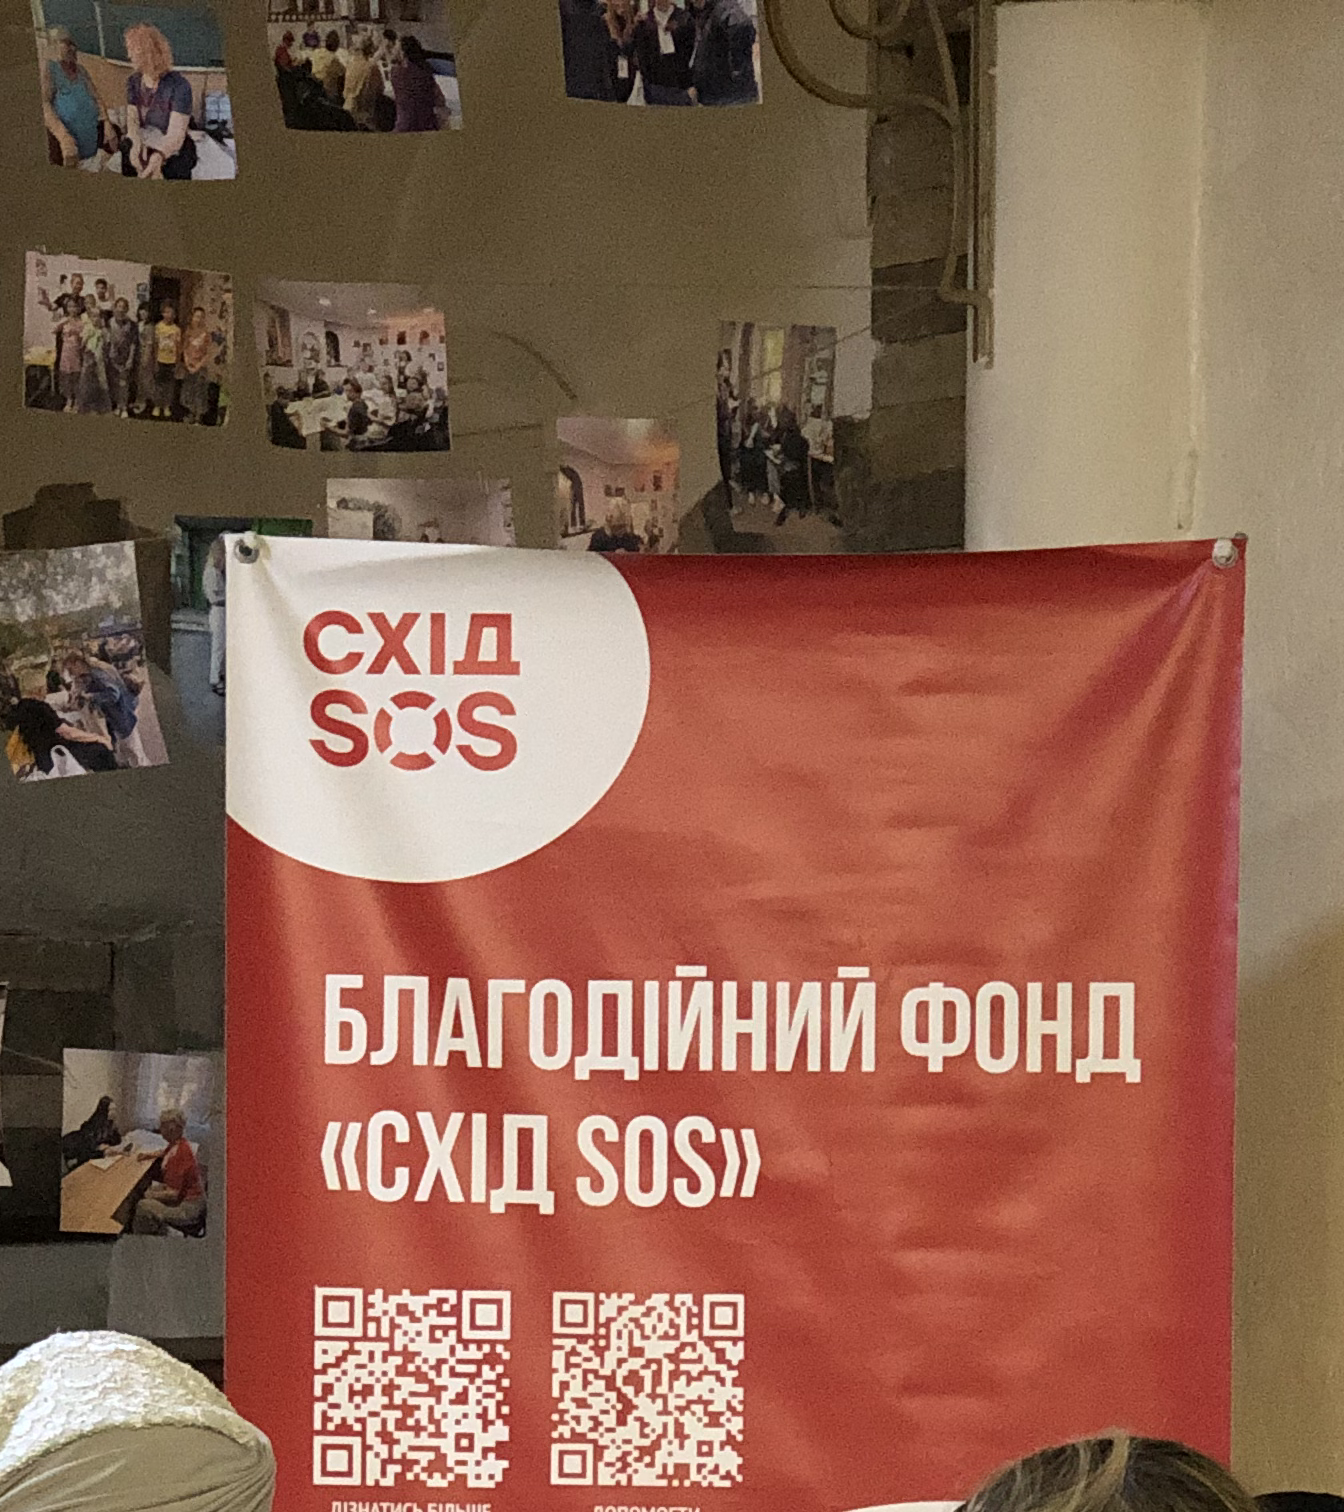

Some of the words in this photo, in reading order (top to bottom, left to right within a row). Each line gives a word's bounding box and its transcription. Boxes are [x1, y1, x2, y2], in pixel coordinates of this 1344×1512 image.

[303, 610, 521, 677] СХІД
[309, 690, 519, 772] SOS
[323, 965, 877, 1082] БЛАГОДІЙНИЙ
[900, 981, 1143, 1083] ФОНД
[321, 1110, 555, 1215] «СХІД
[575, 1114, 761, 1208] SOS»
